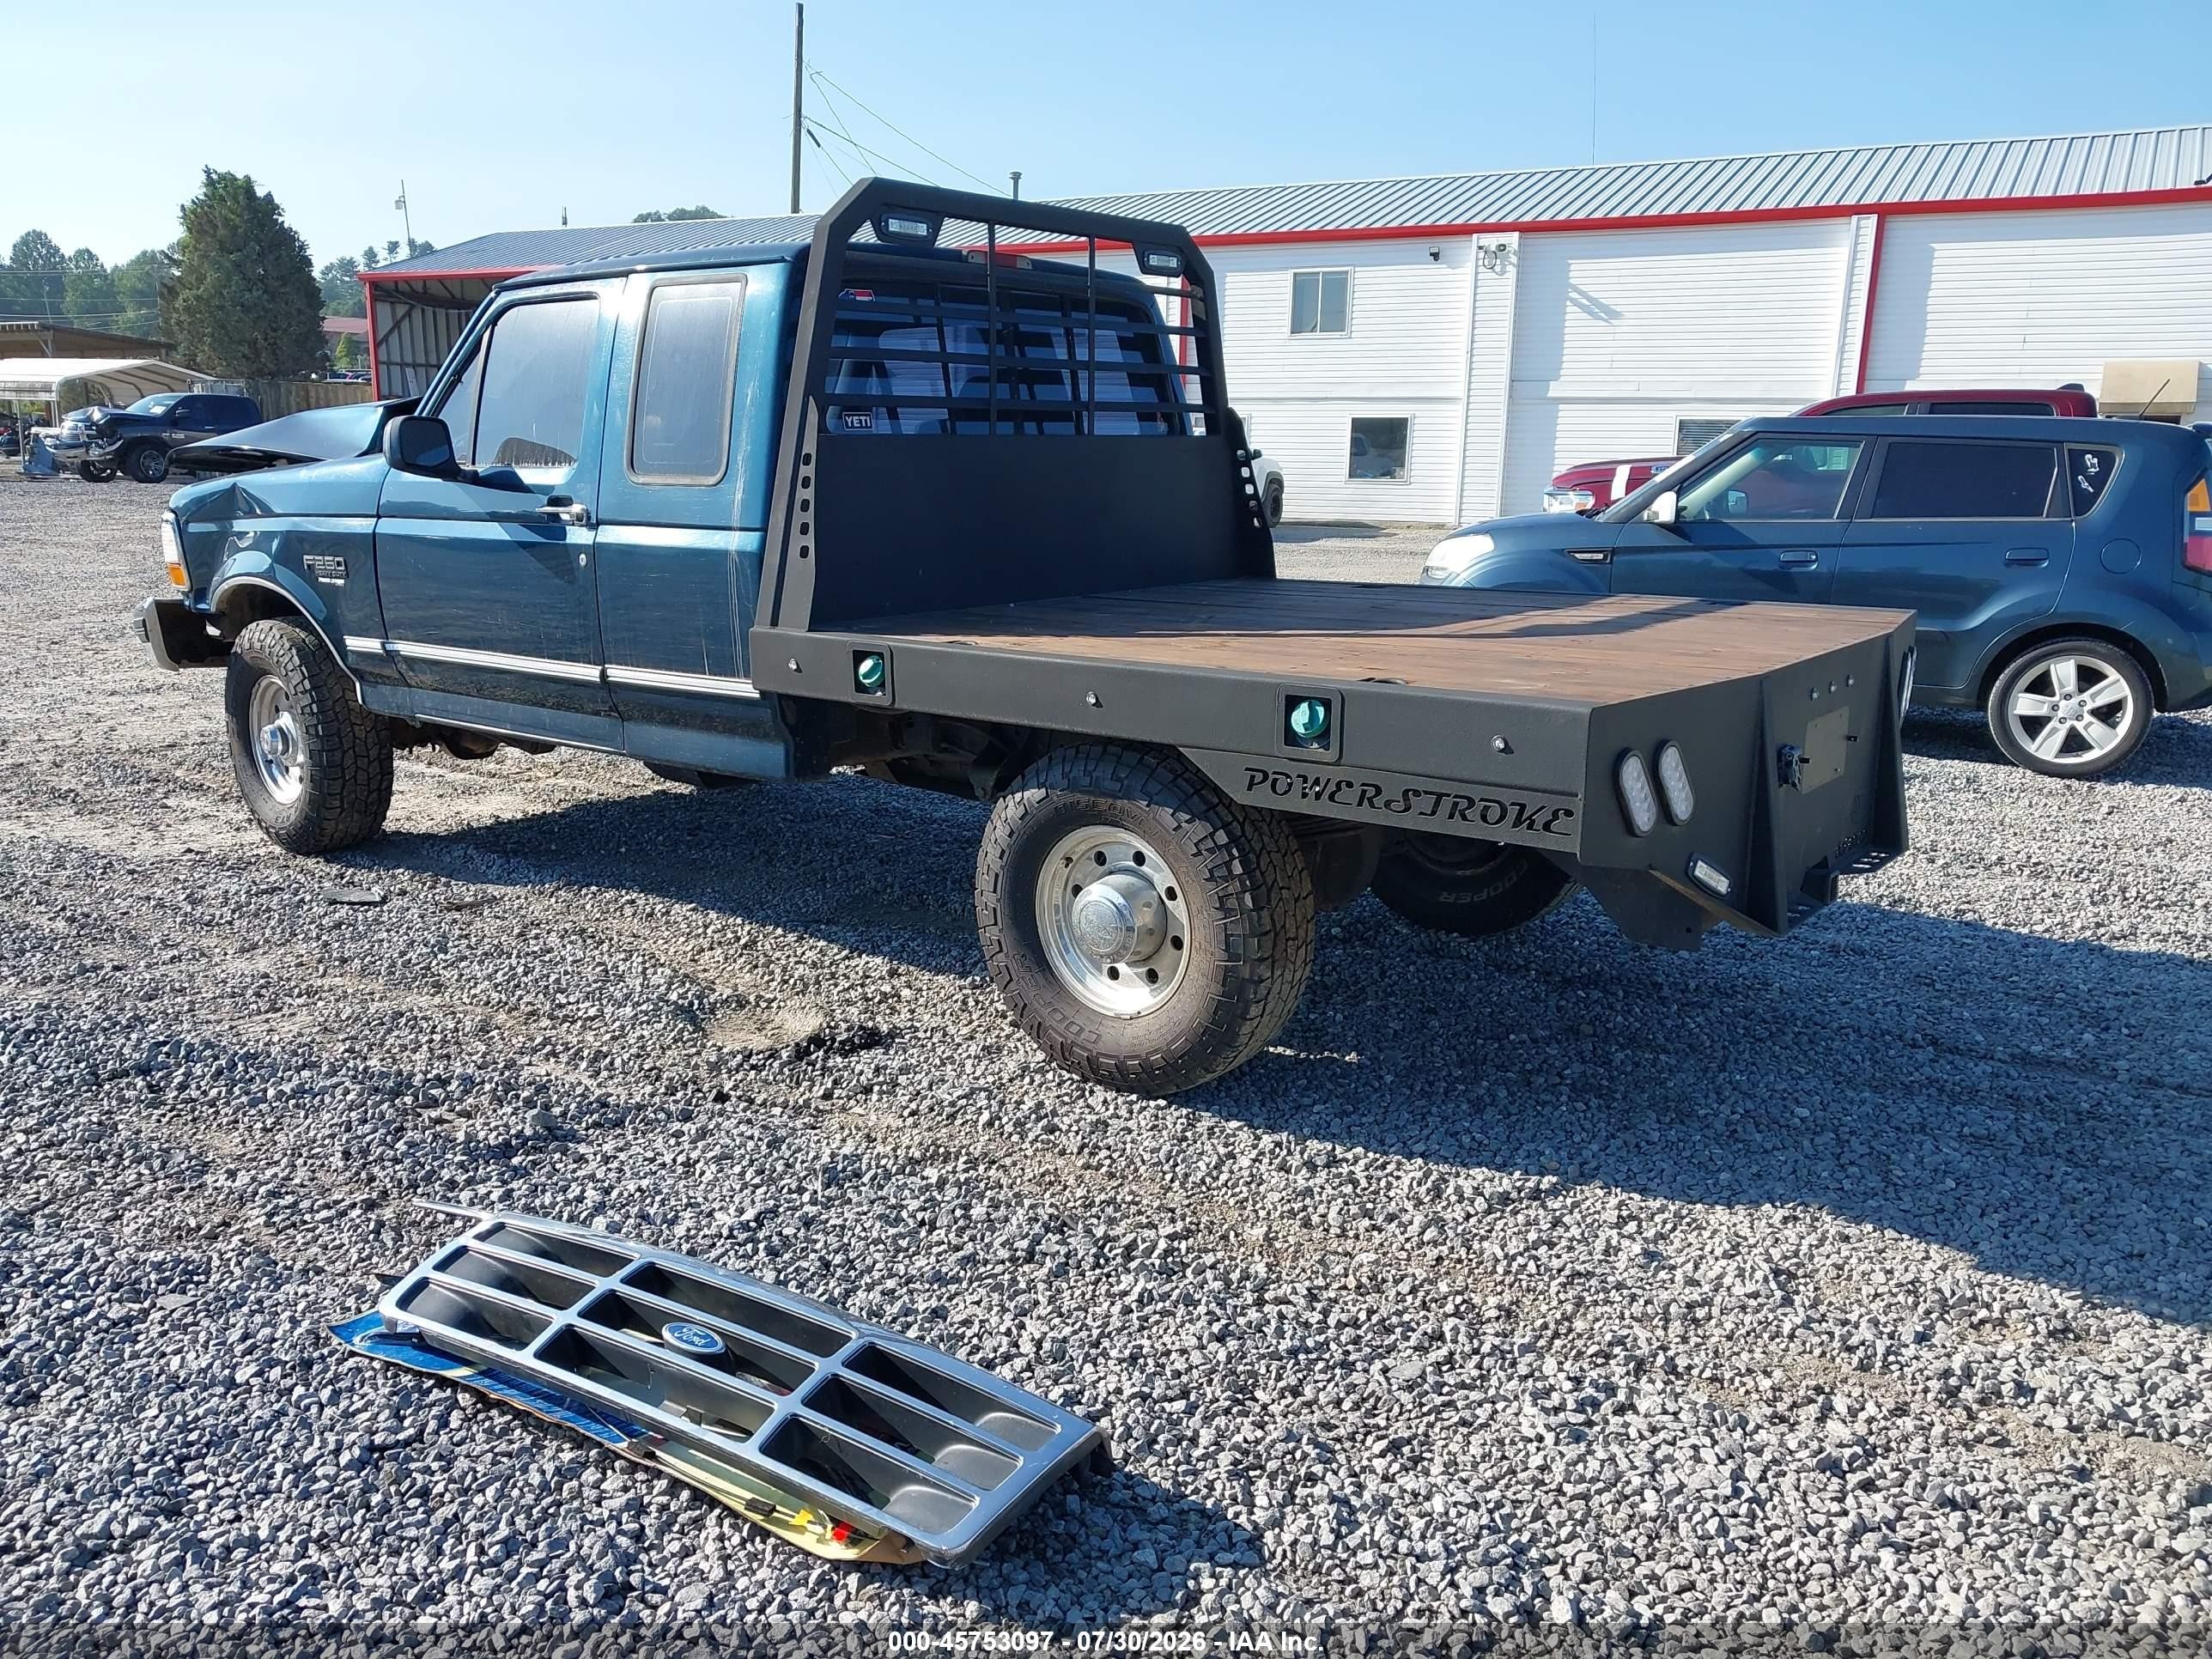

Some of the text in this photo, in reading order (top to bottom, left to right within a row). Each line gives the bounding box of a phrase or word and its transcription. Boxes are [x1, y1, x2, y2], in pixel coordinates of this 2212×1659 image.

[845, 416, 872, 428] YETI
[302, 555, 345, 571] F250
[1243, 766, 1576, 837] POWERSTROKE
[1439, 859, 1530, 903] COOPER
[1012, 951, 1102, 1045] COOPER
[673, 1326, 712, 1346] Ford
